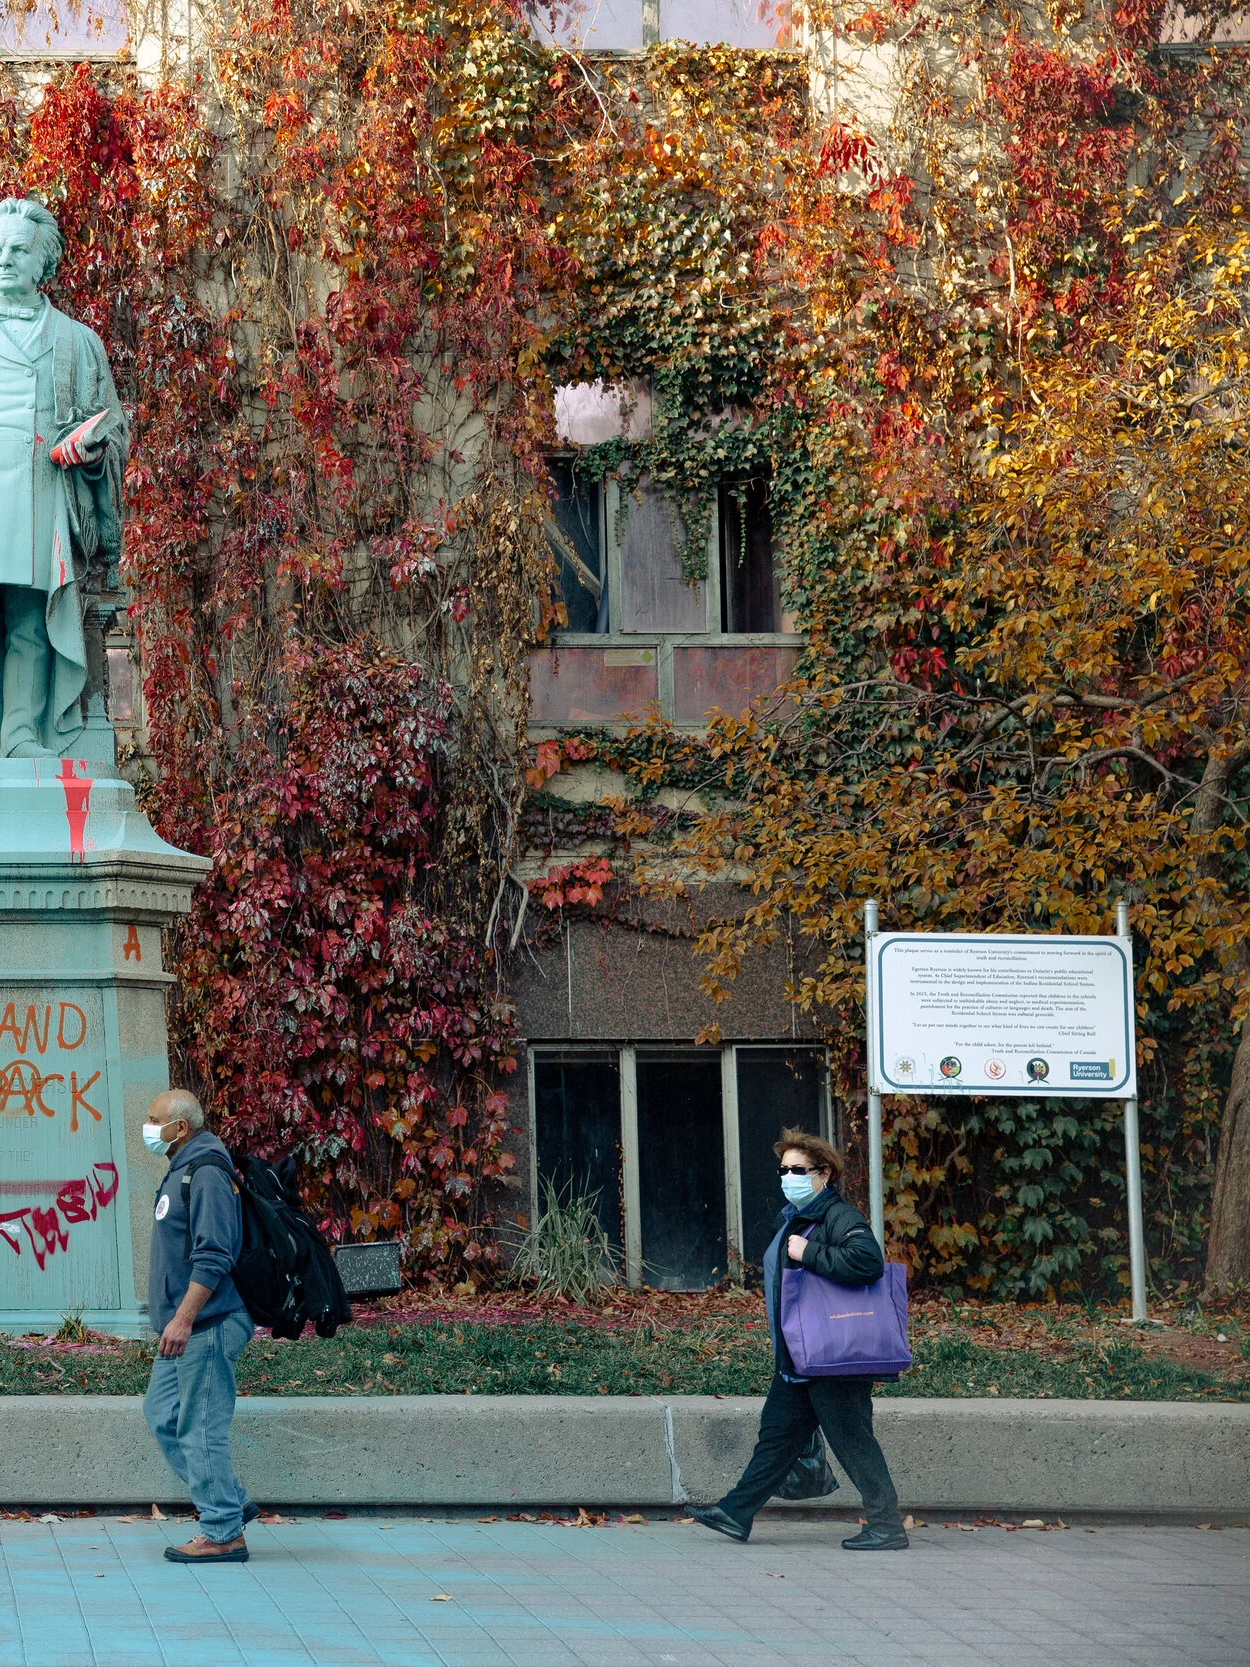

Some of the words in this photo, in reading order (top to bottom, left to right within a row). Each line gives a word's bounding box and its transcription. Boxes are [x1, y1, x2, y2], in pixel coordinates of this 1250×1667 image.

[122, 925, 141, 962] A
[1072, 1064, 1101, 1073] Ryerson
[1073, 1071, 1107, 1079] University
